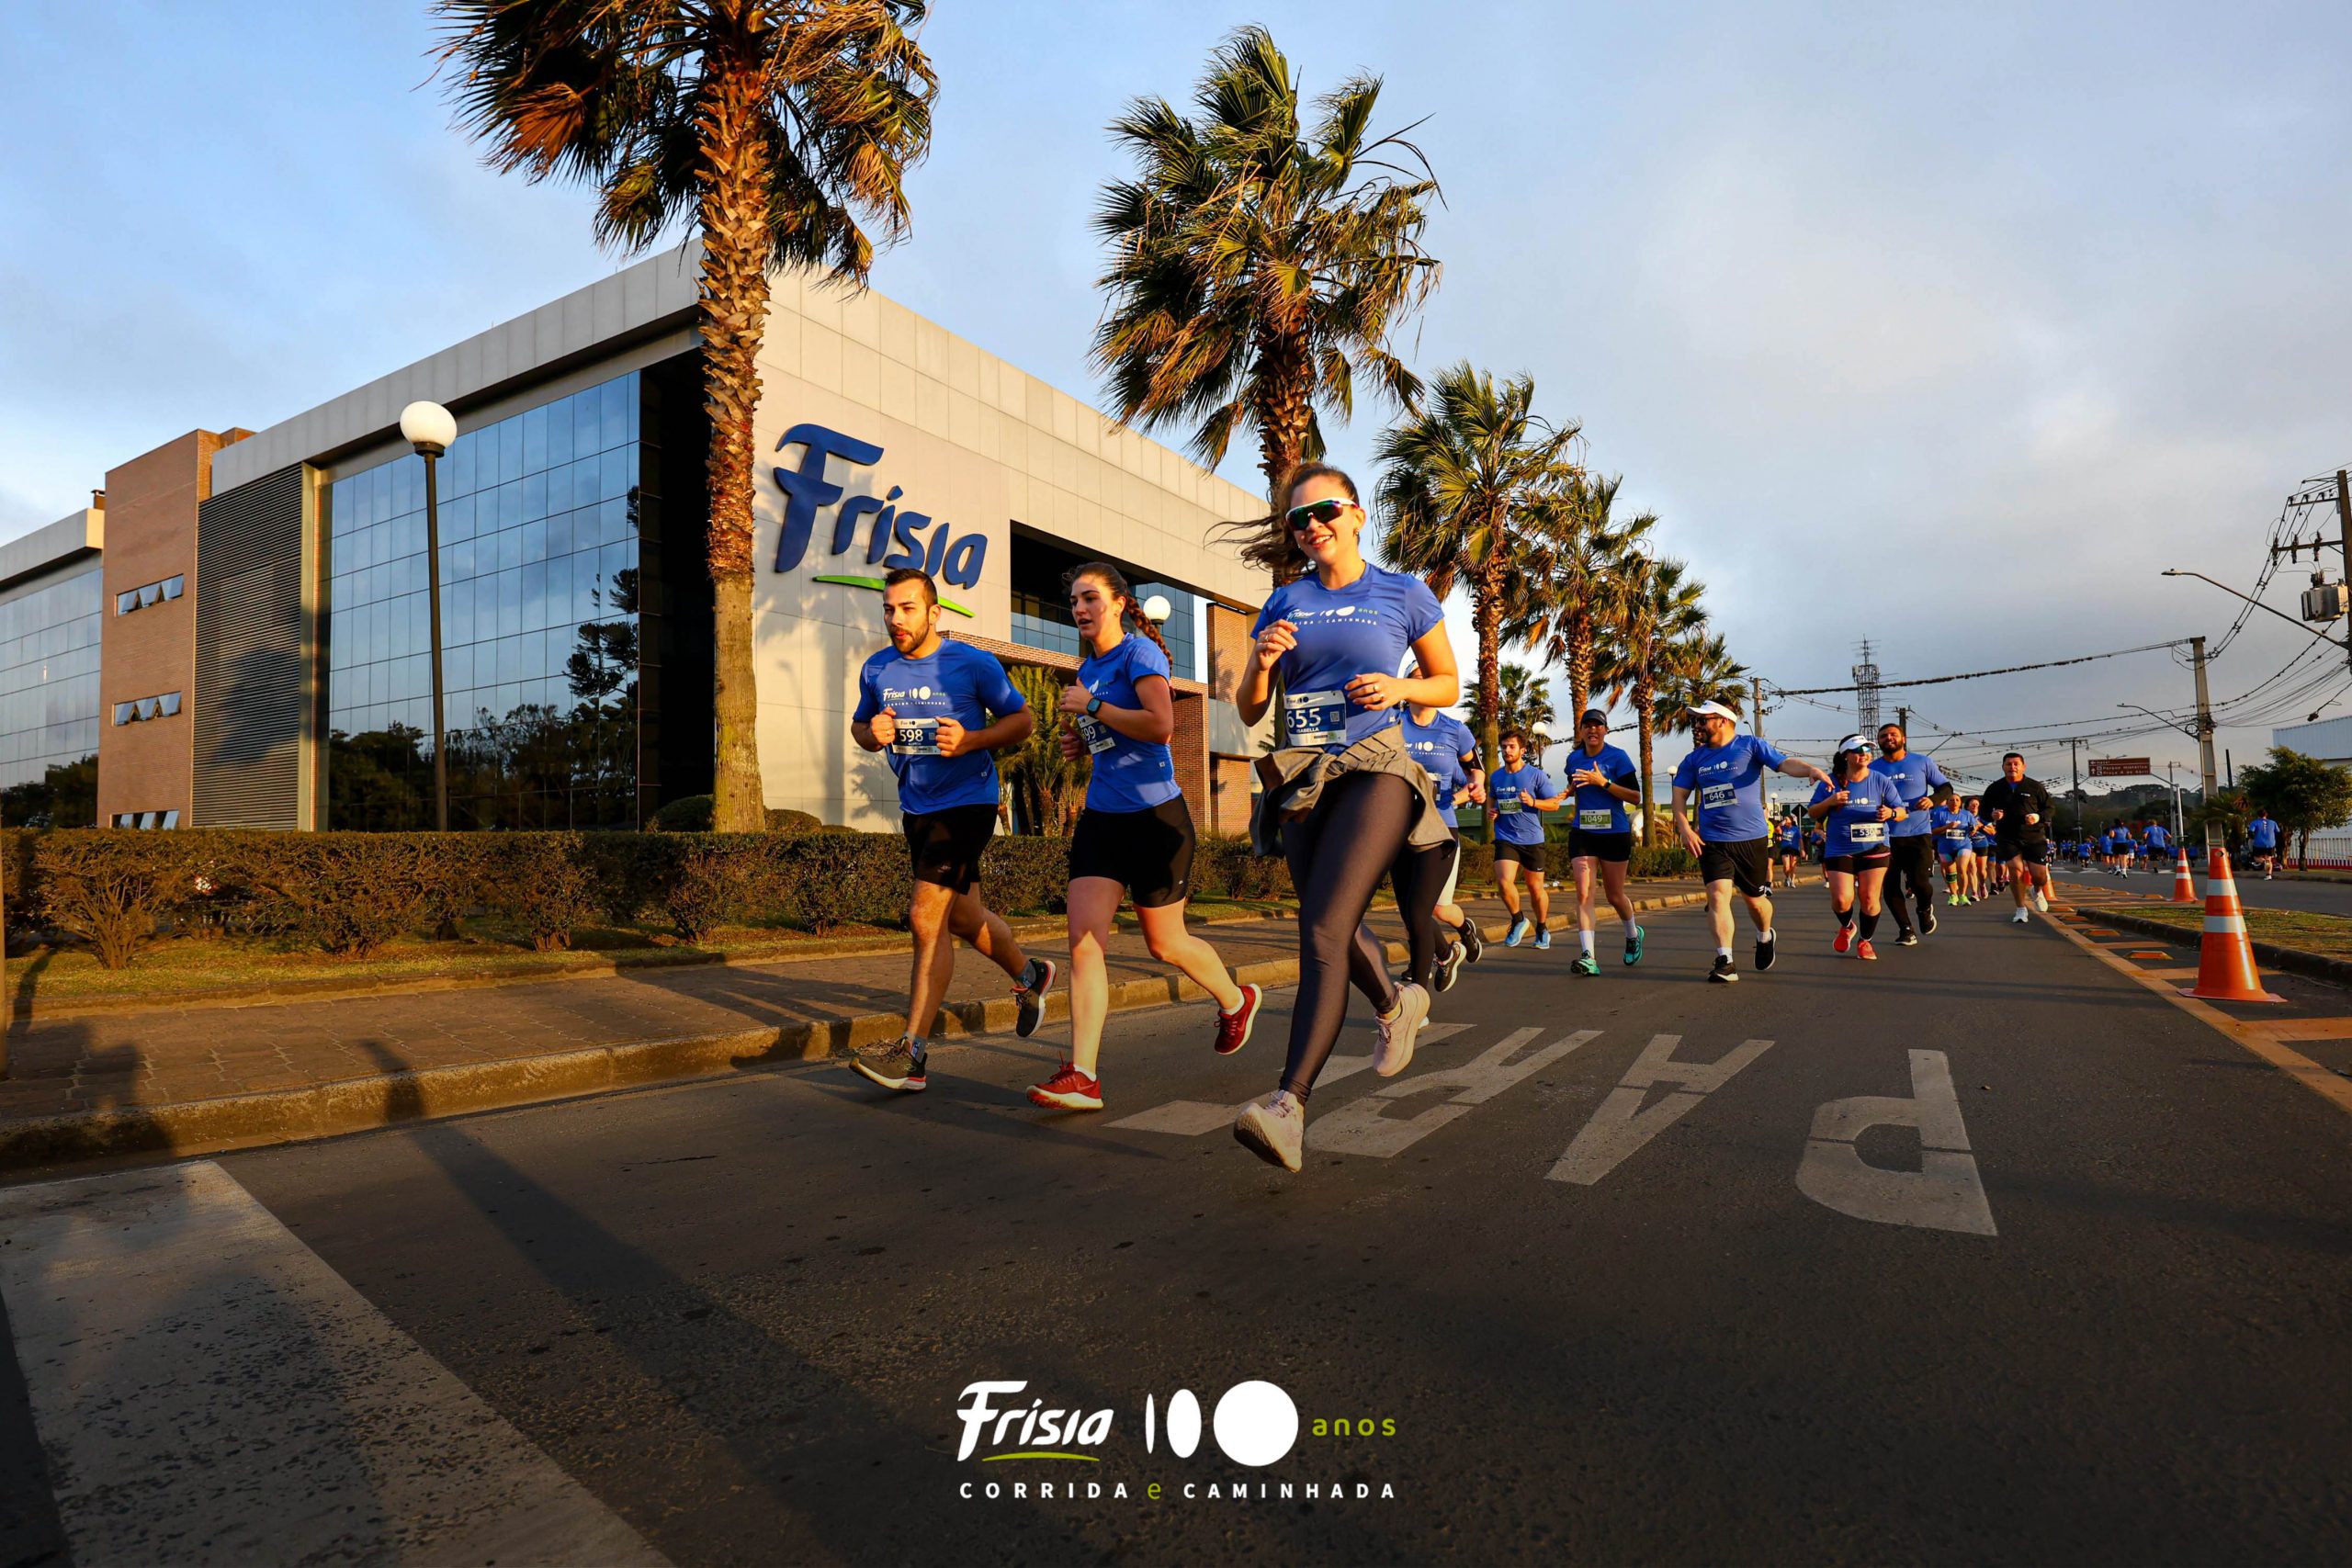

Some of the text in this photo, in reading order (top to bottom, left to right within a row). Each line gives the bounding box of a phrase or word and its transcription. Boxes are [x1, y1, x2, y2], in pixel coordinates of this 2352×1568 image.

[774, 423, 988, 589] Frísia
[910, 686, 931, 700] 100
[899, 729, 923, 742] 598
[1081, 725, 1096, 741] 99
[1709, 791, 1725, 801] 646
[1585, 815, 1603, 823] 1049
